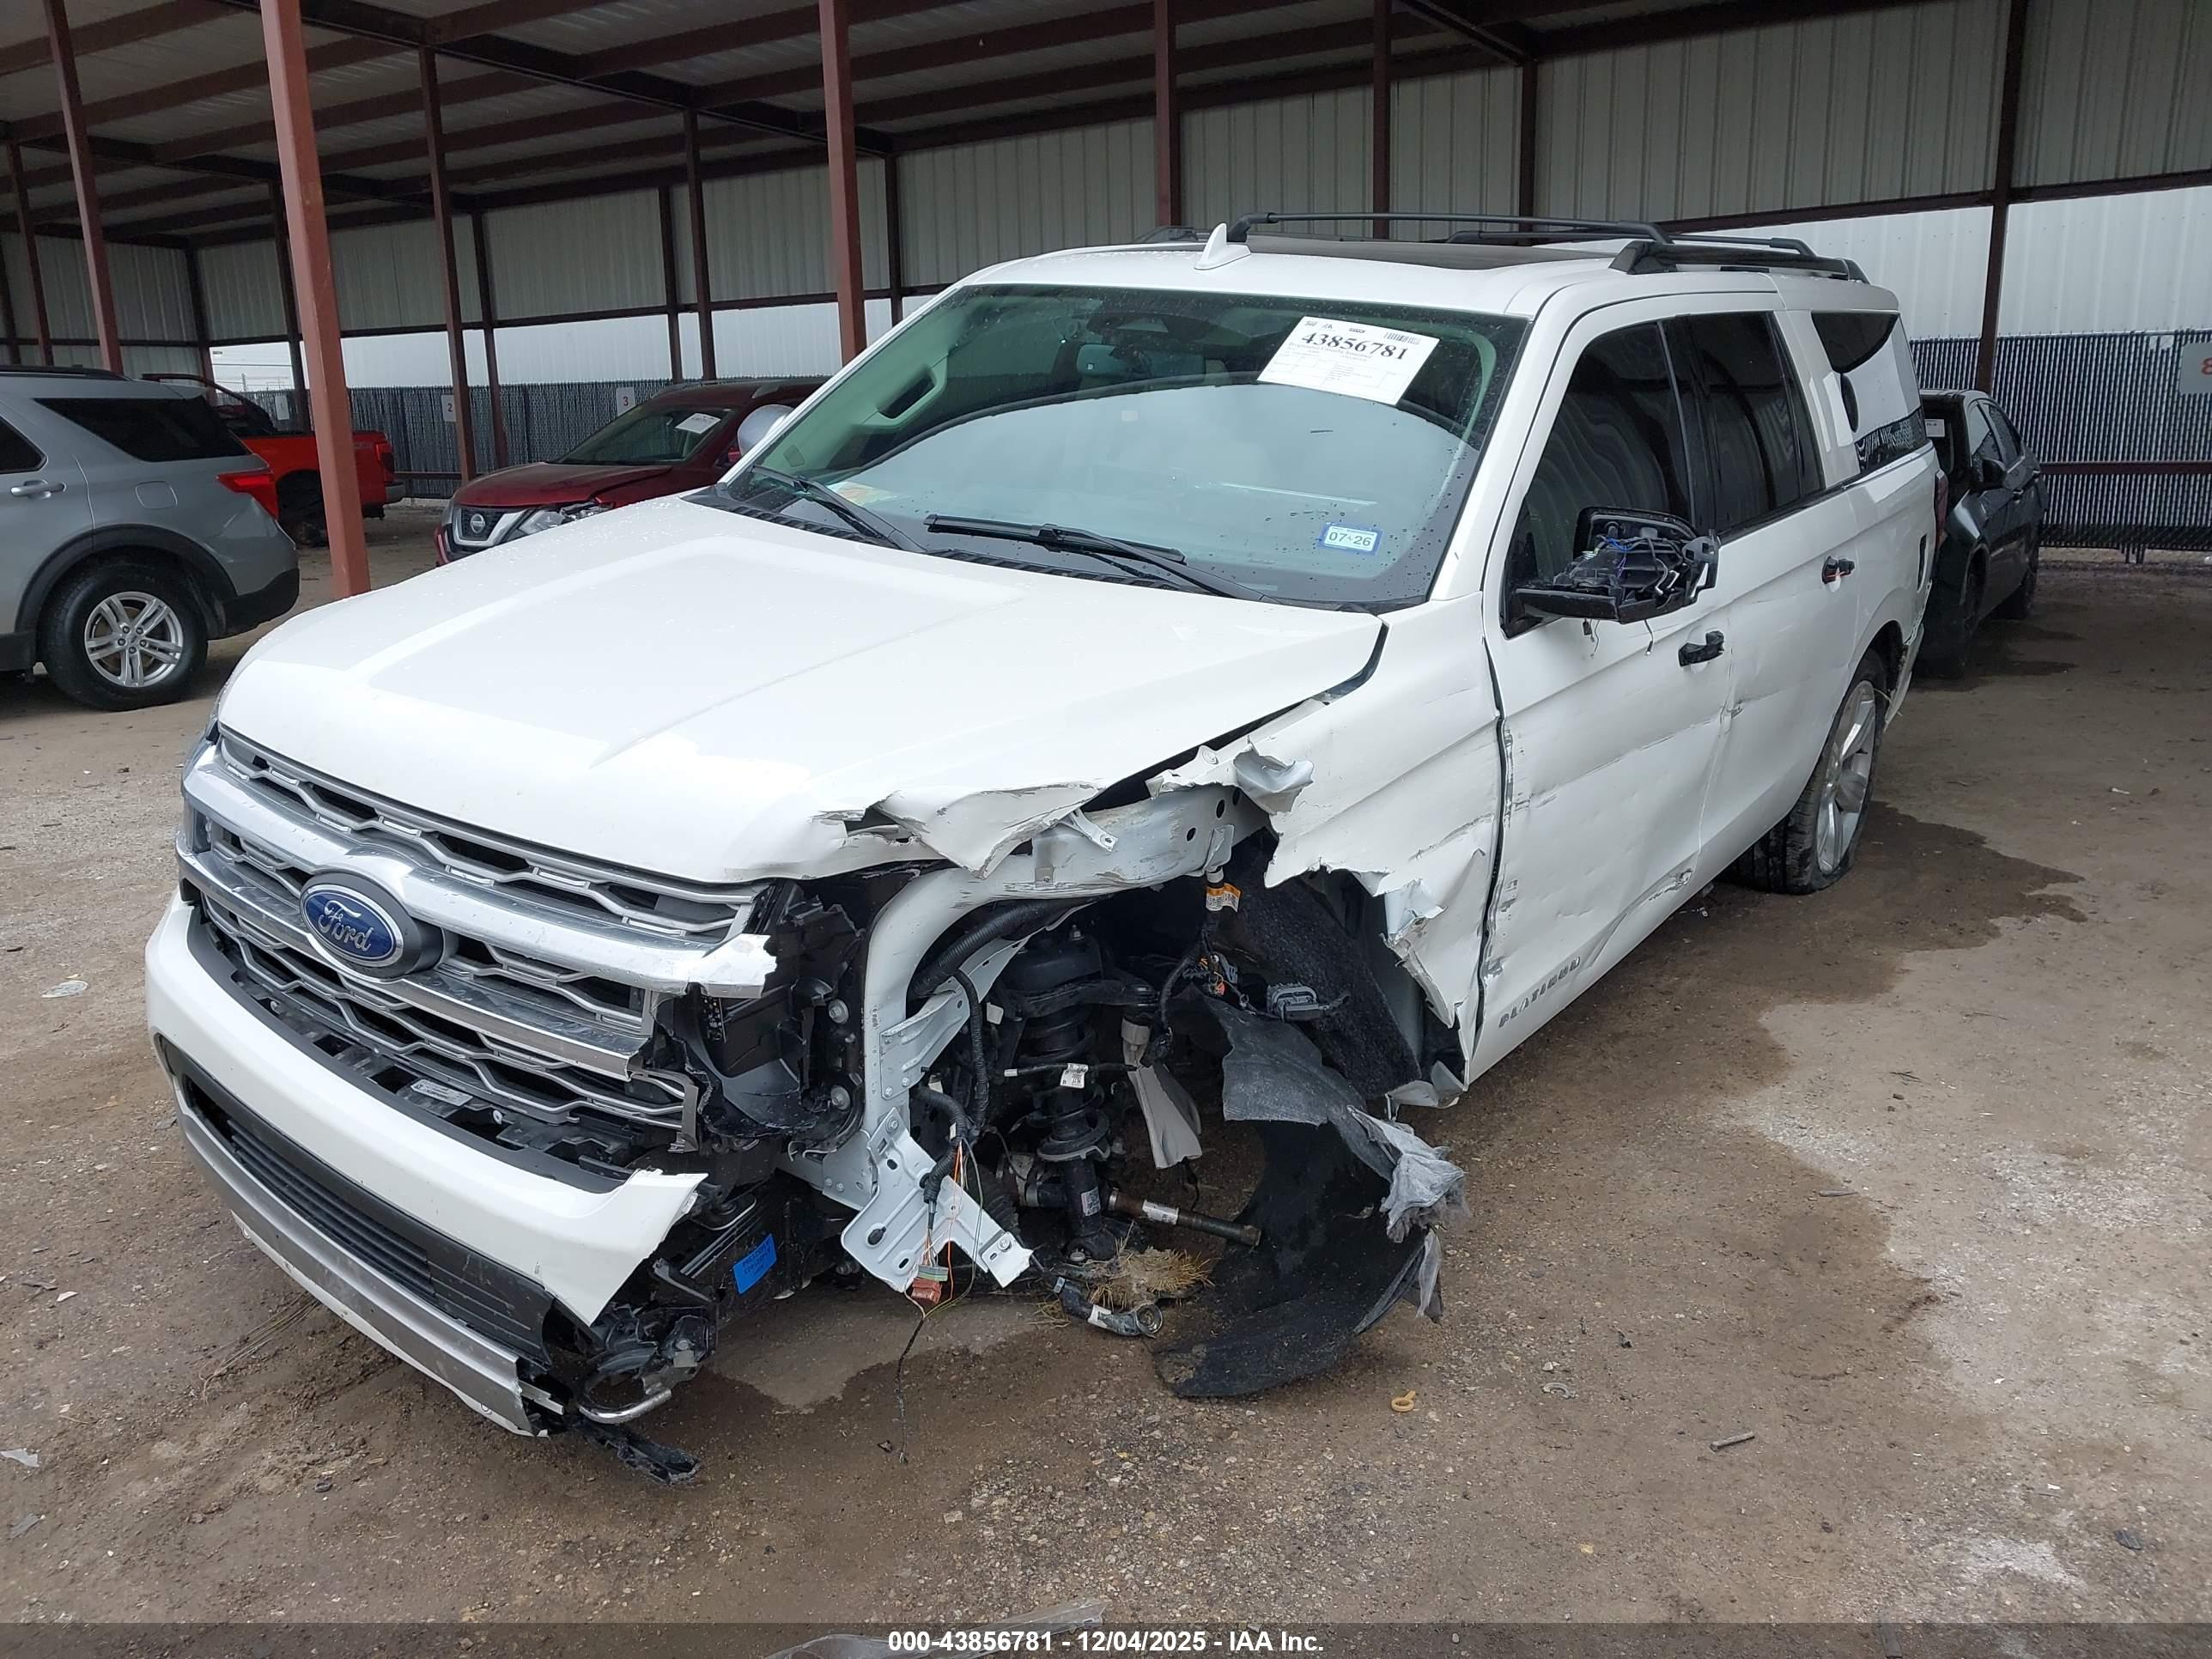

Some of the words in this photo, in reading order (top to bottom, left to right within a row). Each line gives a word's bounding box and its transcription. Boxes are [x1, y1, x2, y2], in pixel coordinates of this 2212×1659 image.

[1302, 331, 1408, 360] 43856781
[447, 403, 453, 412] 2
[623, 396, 629, 406] 3
[1328, 532, 1347, 542] 07
[1352, 536, 1372, 546] 26
[318, 900, 374, 951] Ford
